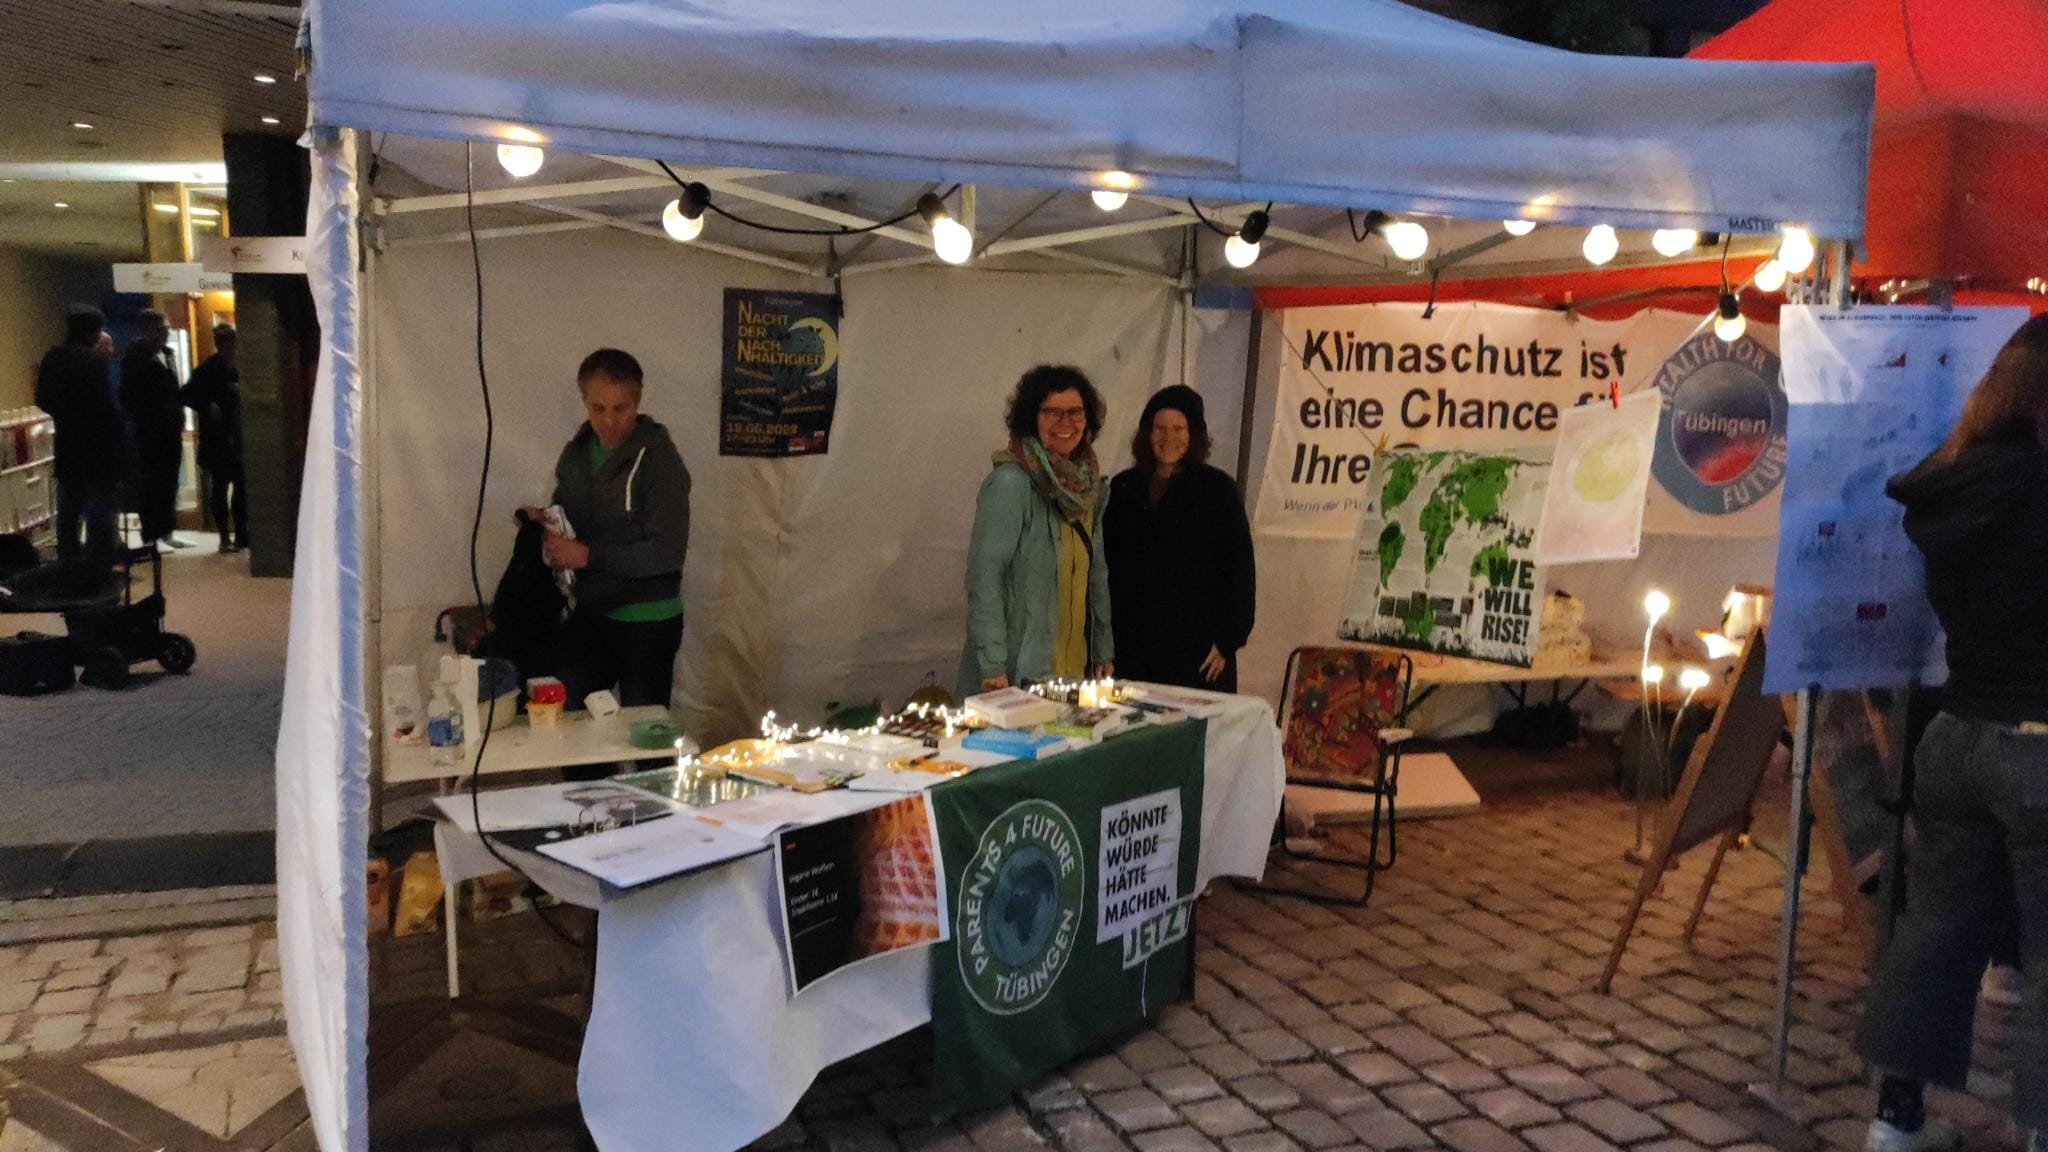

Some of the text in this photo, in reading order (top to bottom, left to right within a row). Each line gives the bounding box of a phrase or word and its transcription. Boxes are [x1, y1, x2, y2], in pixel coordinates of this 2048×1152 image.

[737, 325, 766, 337] DER
[1303, 328, 1627, 379] Klimaschutz ist
[1299, 387, 1559, 431] eine Chance
[1291, 443, 1372, 485] Ihre
[1488, 558, 1535, 590] WE
[1484, 588, 1532, 616] WILL
[1481, 615, 1530, 647] RISE!
[1107, 805, 1168, 840] KÖNNTE
[1106, 834, 1160, 868] WÜRDE
[967, 814, 1075, 976] PARENTS 4 FUTURE
[1106, 864, 1147, 897] HÄTTE
[1104, 884, 1171, 926] MACHEN.
[995, 909, 1075, 1001] TÜBINGEN
